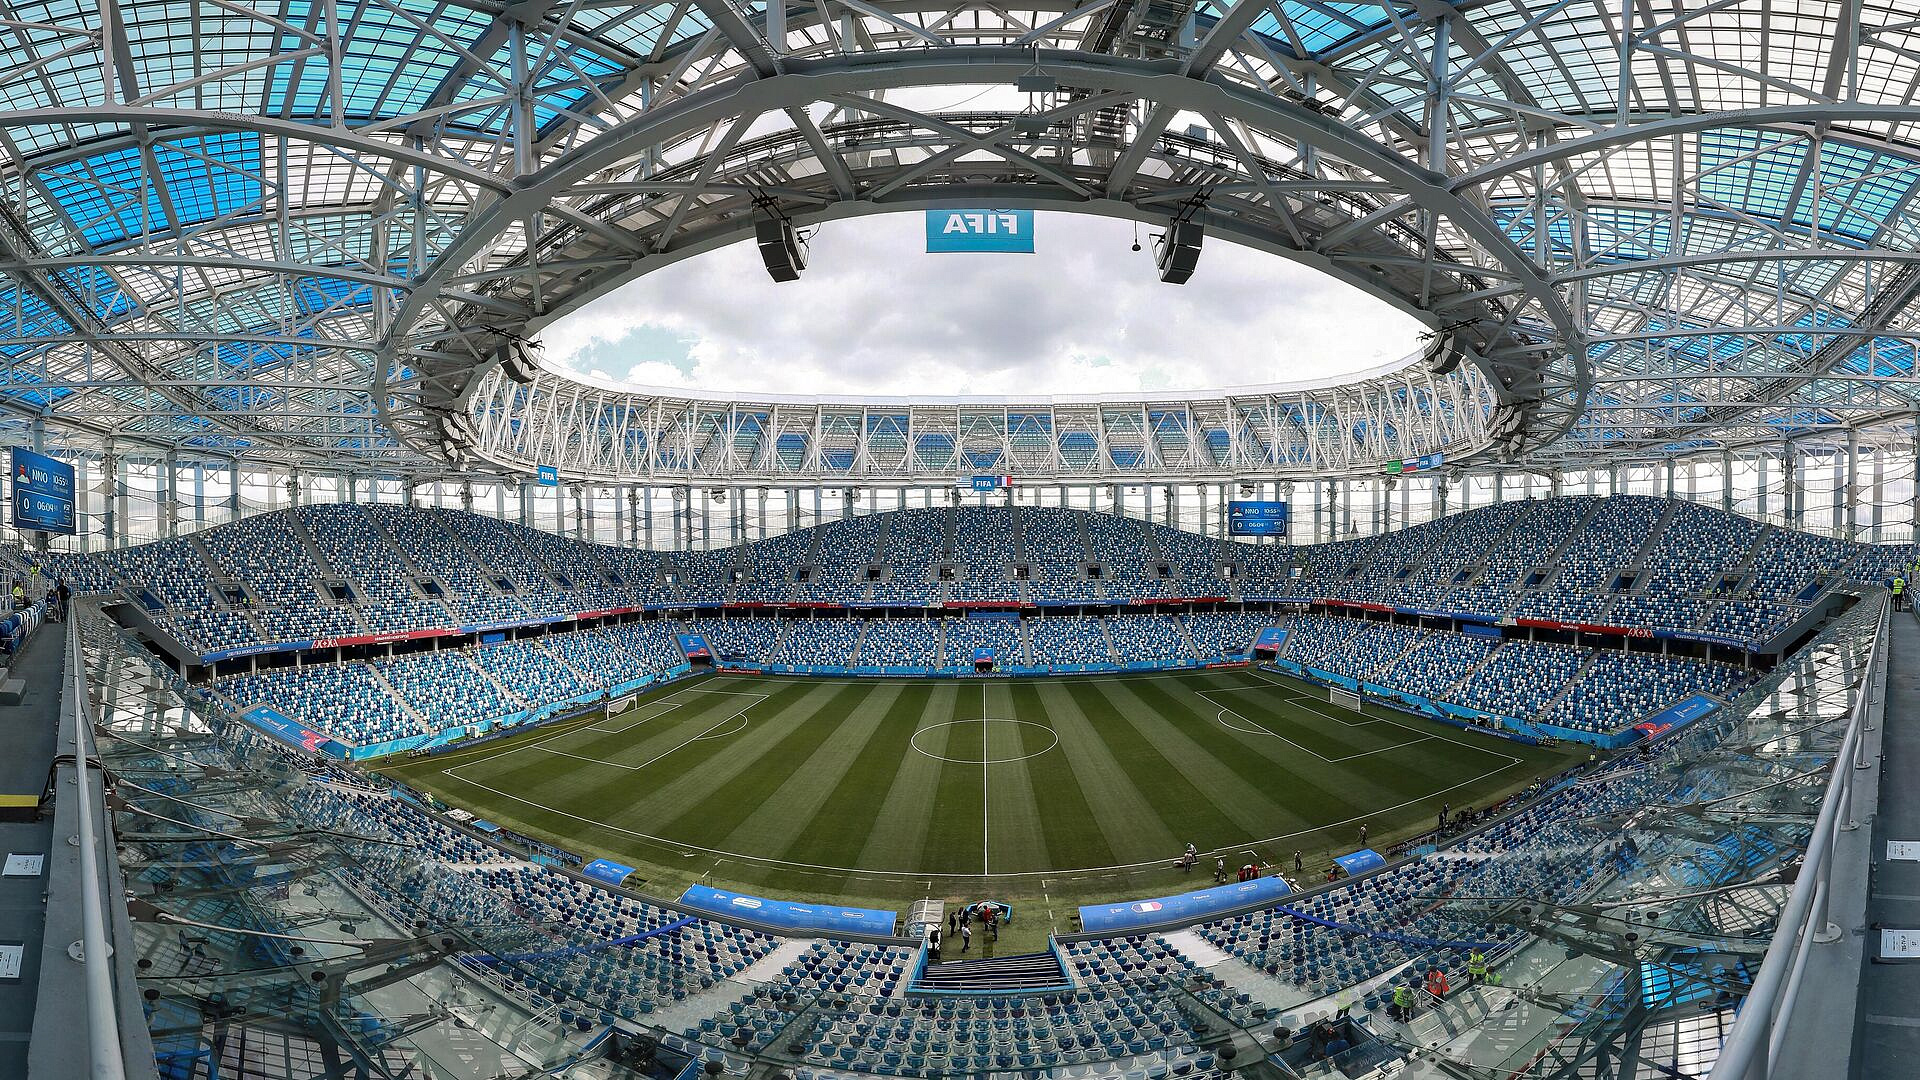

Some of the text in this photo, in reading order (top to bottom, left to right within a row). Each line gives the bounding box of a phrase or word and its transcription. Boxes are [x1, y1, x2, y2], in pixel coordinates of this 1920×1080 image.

[32, 468, 48, 484] NNO
[541, 472, 554, 480] FIFA
[976, 480, 992, 488] FIFA
